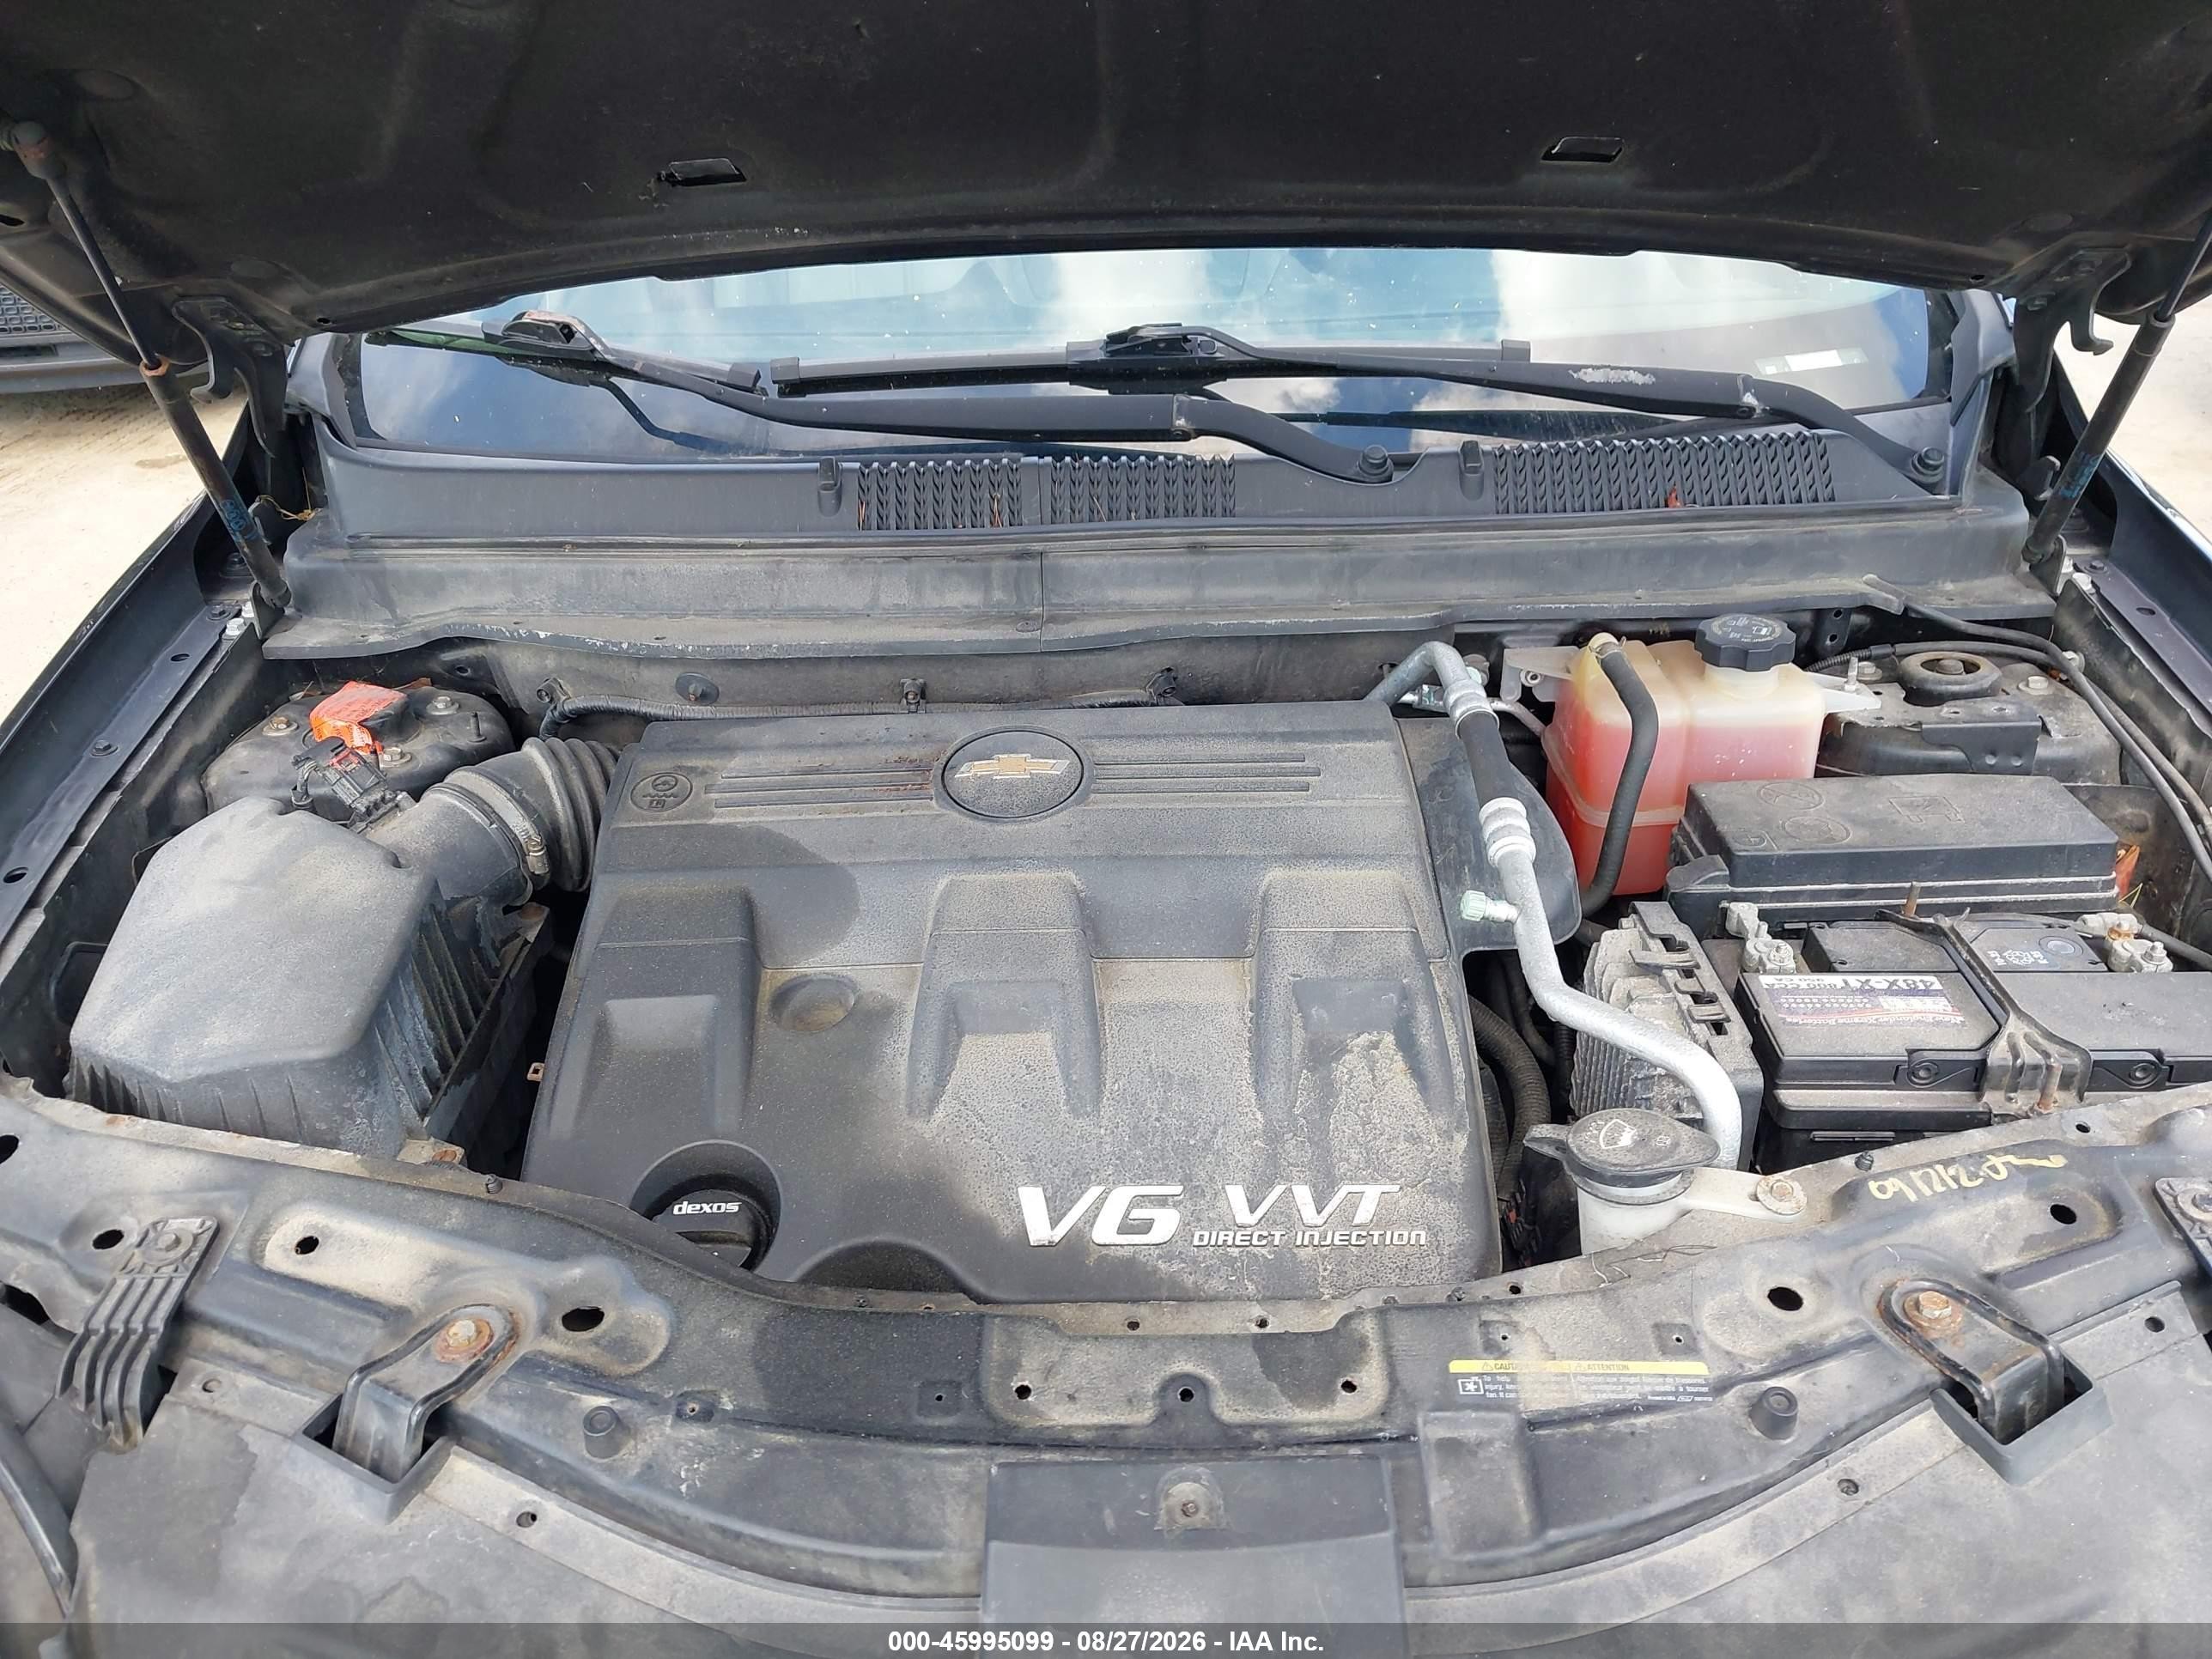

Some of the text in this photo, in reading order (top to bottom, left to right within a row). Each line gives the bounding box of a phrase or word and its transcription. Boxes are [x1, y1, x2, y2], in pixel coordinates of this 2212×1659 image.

[673, 1200, 743, 1215] dexos
[1017, 1184, 1401, 1247] V6 VVT
[1192, 1230, 1427, 1248] DIRECT INJECTION
[1587, 1363, 1630, 1371] ATTENTION
